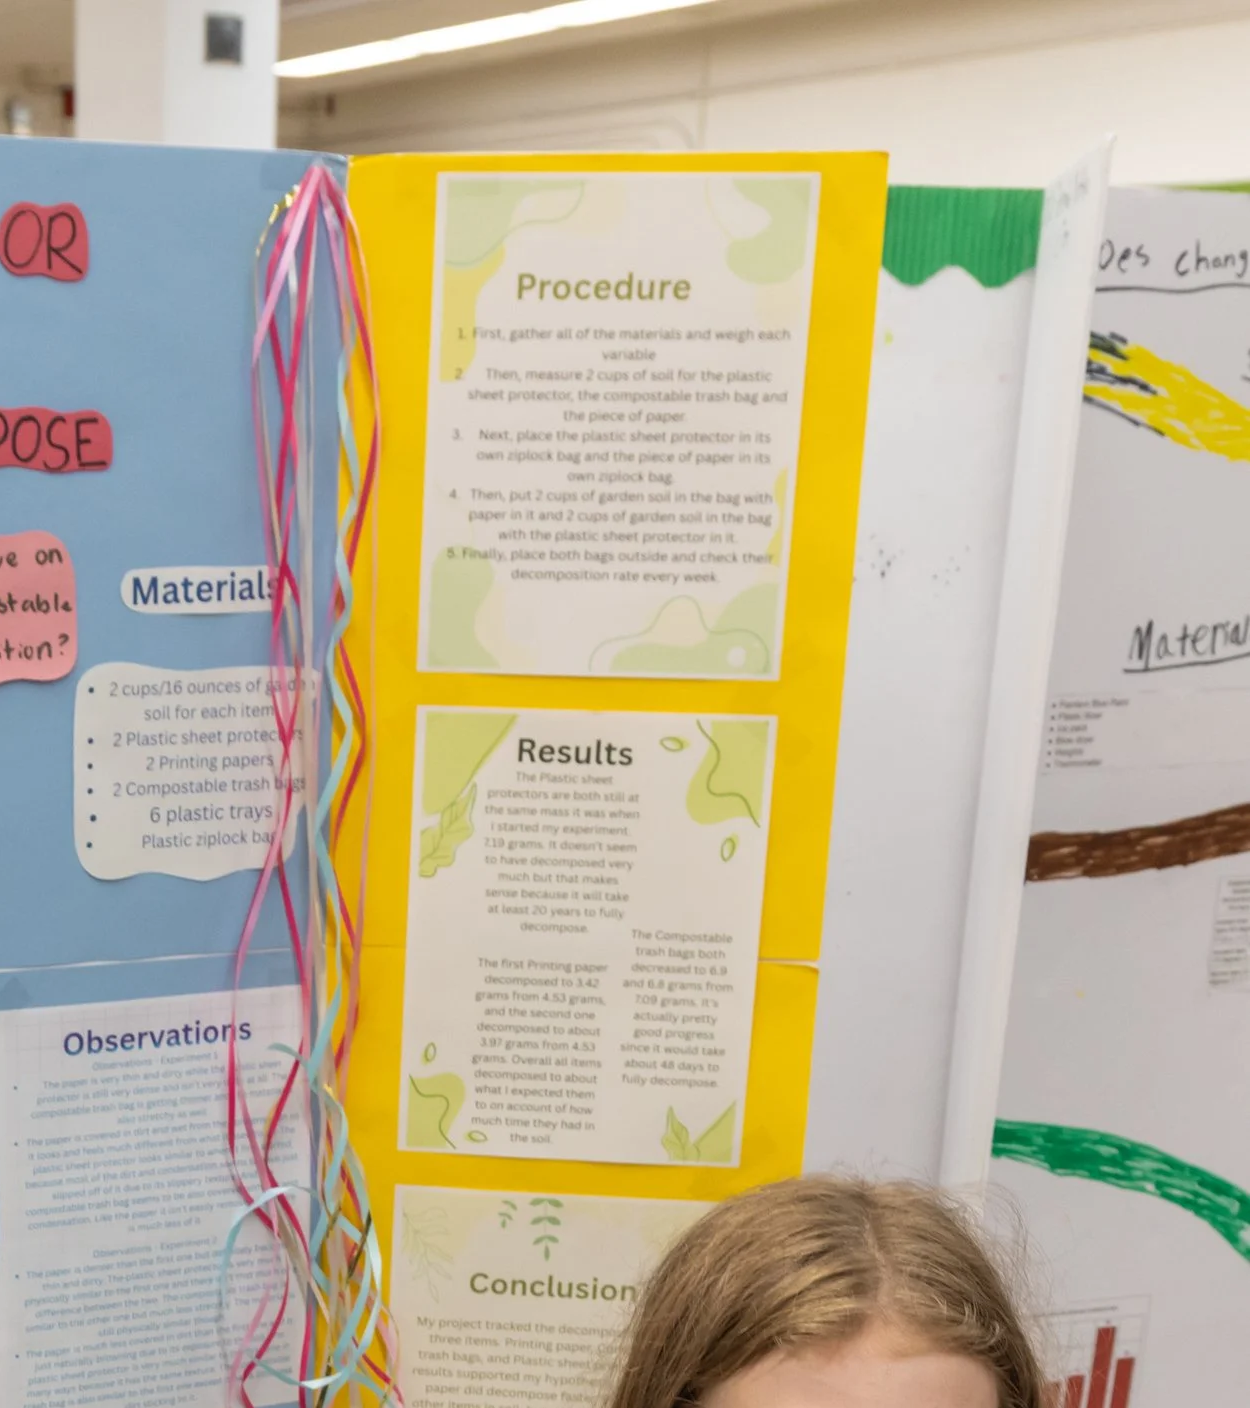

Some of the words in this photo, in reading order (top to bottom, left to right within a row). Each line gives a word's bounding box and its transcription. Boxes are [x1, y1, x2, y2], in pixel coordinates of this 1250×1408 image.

[3, 209, 84, 273] OR
[517, 272, 692, 302] Procedure
[602, 348, 656, 361] variable
[35, 548, 63, 565] on
[110, 682, 119, 697] 2
[187, 680, 241, 694] ounces
[246, 678, 261, 692] of
[144, 707, 170, 721] soil
[175, 706, 196, 720] for
[201, 705, 236, 719] each
[113, 733, 121, 747] 2
[126, 731, 177, 746] Plastic
[181, 730, 222, 744] sheet
[518, 738, 633, 765] Results
[146, 757, 154, 771] 2
[160, 755, 218, 771] Printing
[222, 753, 274, 769] papers
[113, 783, 122, 797] 2
[126, 779, 227, 797] Compostable
[232, 778, 270, 791] trash
[150, 807, 160, 823] 6
[167, 804, 224, 825] plastic
[230, 804, 273, 823] trays
[142, 833, 191, 848] Plastic
[196, 832, 247, 848] ziplock
[64, 1020, 251, 1056] Observations
[470, 1272, 636, 1301] Conclusion
